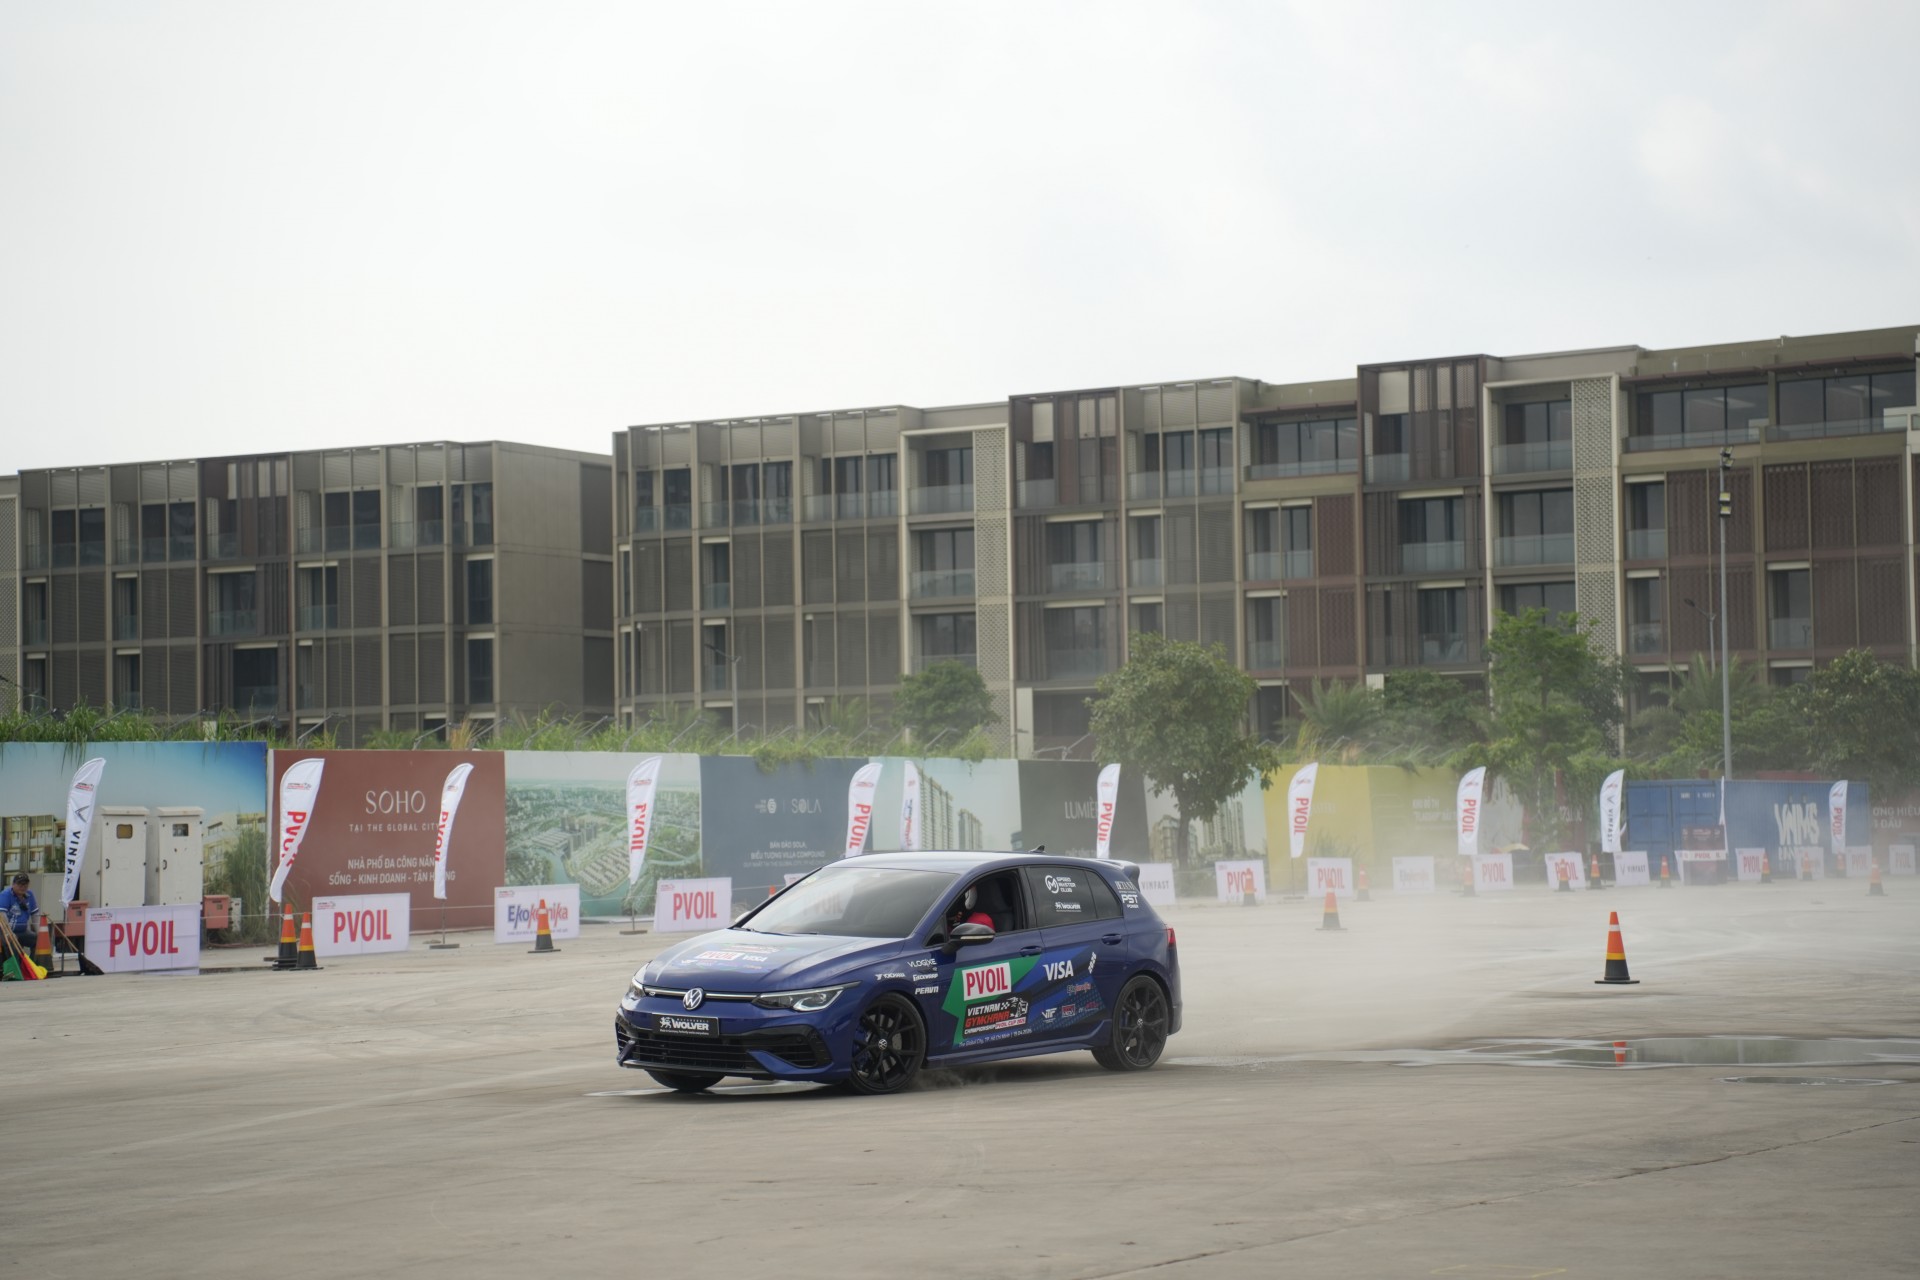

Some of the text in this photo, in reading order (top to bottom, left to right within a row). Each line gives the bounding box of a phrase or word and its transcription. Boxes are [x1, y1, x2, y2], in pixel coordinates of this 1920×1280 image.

[365, 790, 426, 814] SOHO
[1294, 797, 1309, 835] PVOIL
[1462, 798, 1477, 834] PVOIL
[367, 824, 383, 832] THE
[387, 823, 418, 832] GLOBAL
[358, 873, 378, 885] KINH
[379, 872, 407, 884] DOANH
[1482, 862, 1506, 882] PVOIL
[1141, 880, 1169, 890] VINFAST
[673, 891, 717, 921] PVOIL
[1121, 894, 1138, 904] PST
[333, 908, 392, 944] PVOIL
[109, 919, 179, 958] PVOIL
[1043, 960, 1075, 981] VISA
[966, 967, 1008, 997] PVOIL
[965, 1010, 1010, 1028] GYMKHANA
[967, 1002, 1001, 1017] VIETNAM
[671, 1017, 710, 1031] WOLVER
